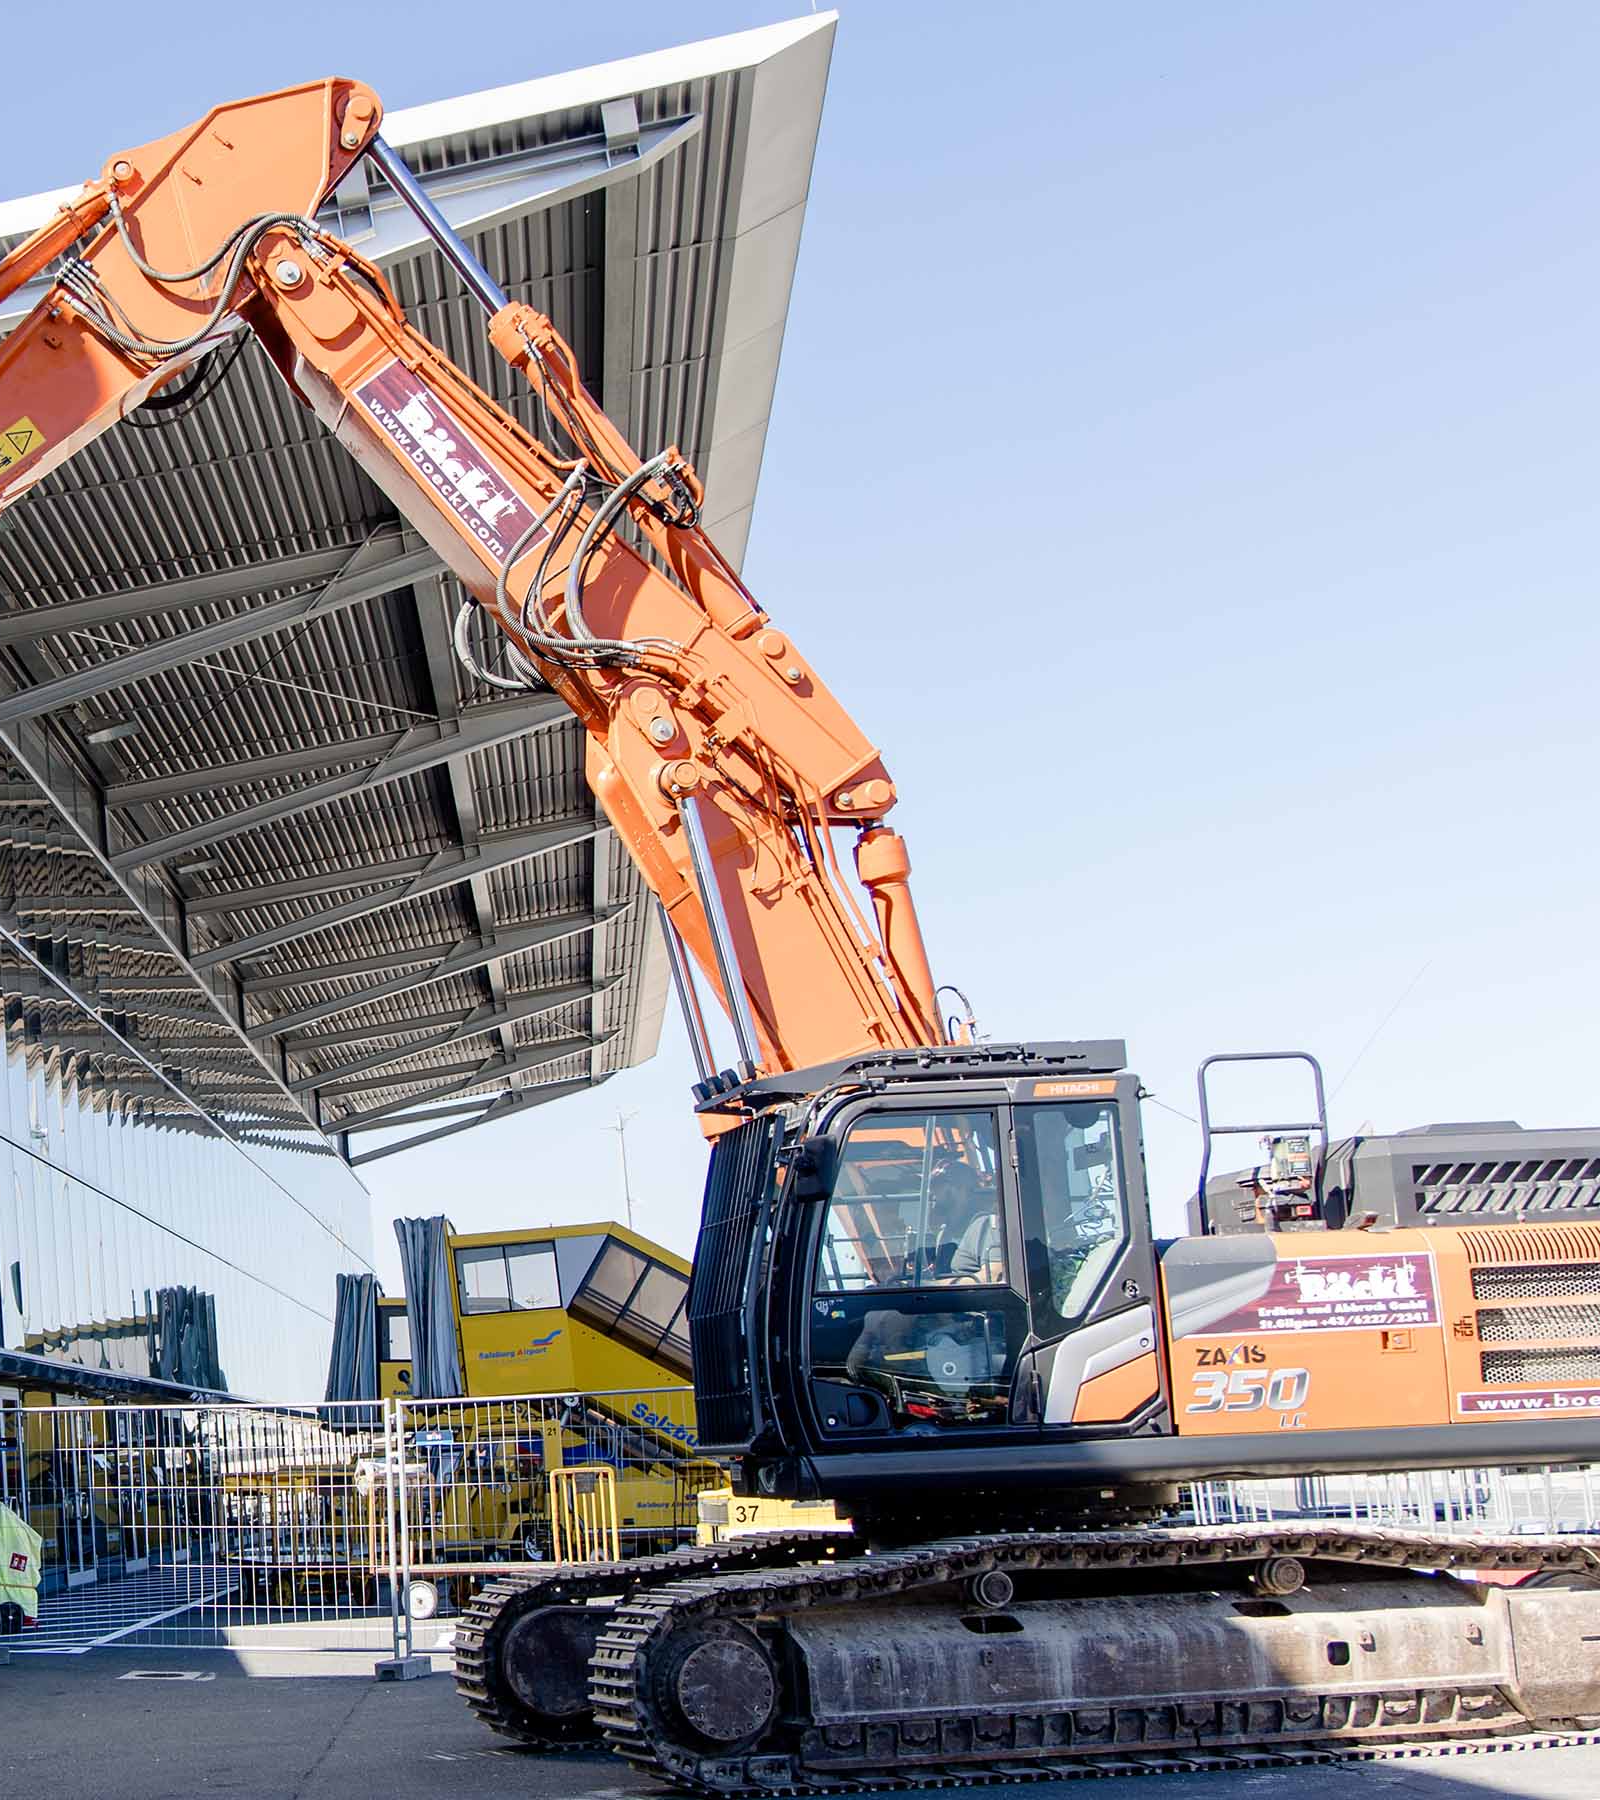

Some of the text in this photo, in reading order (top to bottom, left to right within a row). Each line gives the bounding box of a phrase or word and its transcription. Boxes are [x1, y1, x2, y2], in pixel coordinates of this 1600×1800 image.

[367, 398, 505, 557] www.boeckl.com
[1049, 1083, 1100, 1095] HITACHI
[1306, 1304, 1331, 1316] und
[1335, 1301, 1387, 1314] Abbruch
[1389, 1299, 1428, 1311] GmbH
[1195, 1342, 1266, 1366] ZAXIS
[1185, 1367, 1310, 1414] 350
[1280, 1412, 1307, 1428] LC
[546, 1427, 557, 1437] 21
[735, 1505, 759, 1523] 37
